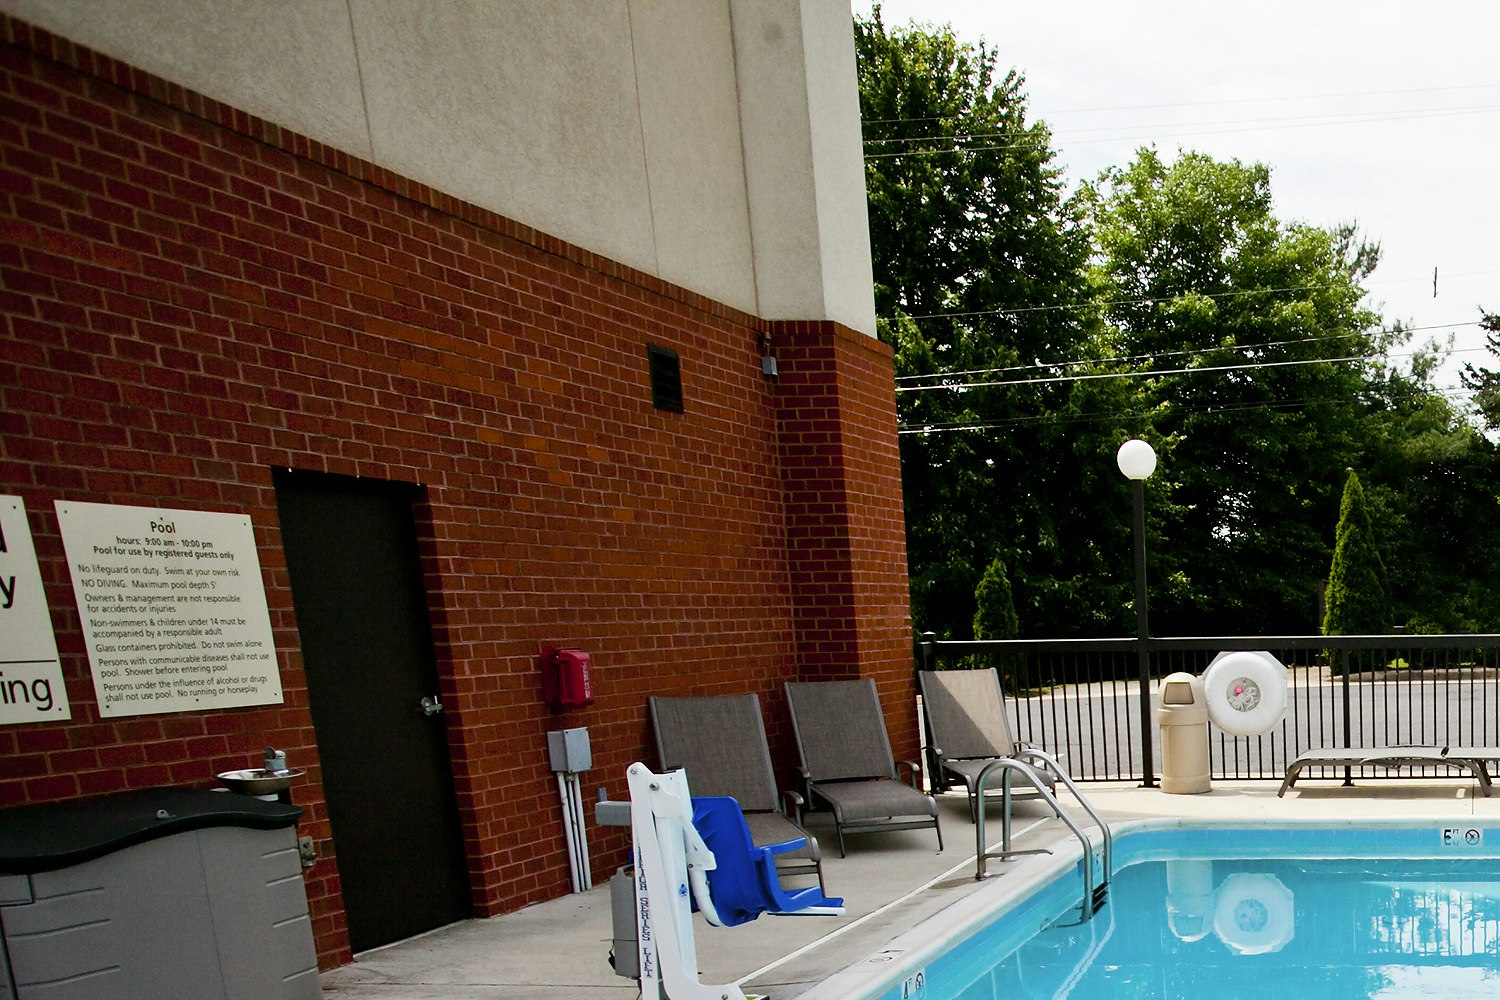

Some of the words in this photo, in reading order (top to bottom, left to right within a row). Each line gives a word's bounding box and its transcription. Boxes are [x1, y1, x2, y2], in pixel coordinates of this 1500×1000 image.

[150, 521, 176, 534] Pool
[116, 535, 142, 545] hours:
[144, 537, 162, 546] 9:00
[181, 539, 200, 547] 10:00
[201, 541, 213, 550] pm
[93, 545, 113, 555] Pool
[114, 545, 126, 555] for
[143, 548, 153, 558] by
[155, 549, 193, 559] registered
[194, 552, 218, 560] guests
[220, 551, 234, 561] only
[78, 564, 90, 573] No
[92, 565, 129, 576] lifeguard
[142, 566, 161, 577] duty.
[164, 566, 185, 575] Swim
[195, 569, 210, 577] your
[228, 569, 240, 577] risk
[81, 579, 95, 588] NO
[97, 579, 128, 588] DIVING.
[132, 580, 169, 589] Maximum
[171, 580, 187, 589] pool
[188, 581, 210, 590] depth
[84, 593, 116, 602] Owners
[117, 594, 124, 602] &
[125, 595, 175, 604] management
[203, 595, 240, 604] responsible
[87, 603, 99, 613] for
[101, 604, 137, 613] accidents
[149, 604, 176, 614] injuries
[90, 618, 148, 628] Non-swimmers
[149, 618, 155, 627] &
[157, 618, 186, 626] children
[187, 617, 208, 626] under
[210, 617, 218, 625] 14
[237, 617, 246, 625] be
[92, 629, 144, 639] accompanied
[145, 629, 155, 638] by
[163, 629, 203, 638] responsible
[204, 627, 223, 636] adult
[95, 644, 116, 653] Glass
[117, 644, 157, 652] containers
[158, 640, 198, 652] prohibited.
[201, 641, 212, 649] Do
[244, 640, 263, 648] alone
[98, 658, 129, 667] Persons
[130, 657, 147, 665] with
[149, 655, 200, 665] communicable
[230, 653, 245, 661] shall
[101, 669, 122, 679] pool.
[125, 668, 153, 676] Shower
[155, 666, 180, 675] before
[181, 666, 211, 675] entering
[212, 664, 228, 673] pool
[103, 683, 133, 691] Persons
[135, 681, 157, 690] under
[173, 679, 205, 687] influence
[216, 677, 240, 685] alcohol
[250, 675, 268, 684] drugs
[0, 671, 54, 712] ing
[105, 693, 124, 702] shall
[126, 693, 139, 701] not
[140, 692, 153, 700] use
[155, 690, 174, 702] pool.
[177, 689, 188, 697] No
[189, 688, 217, 697] running
[227, 685, 258, 695] horseplay
